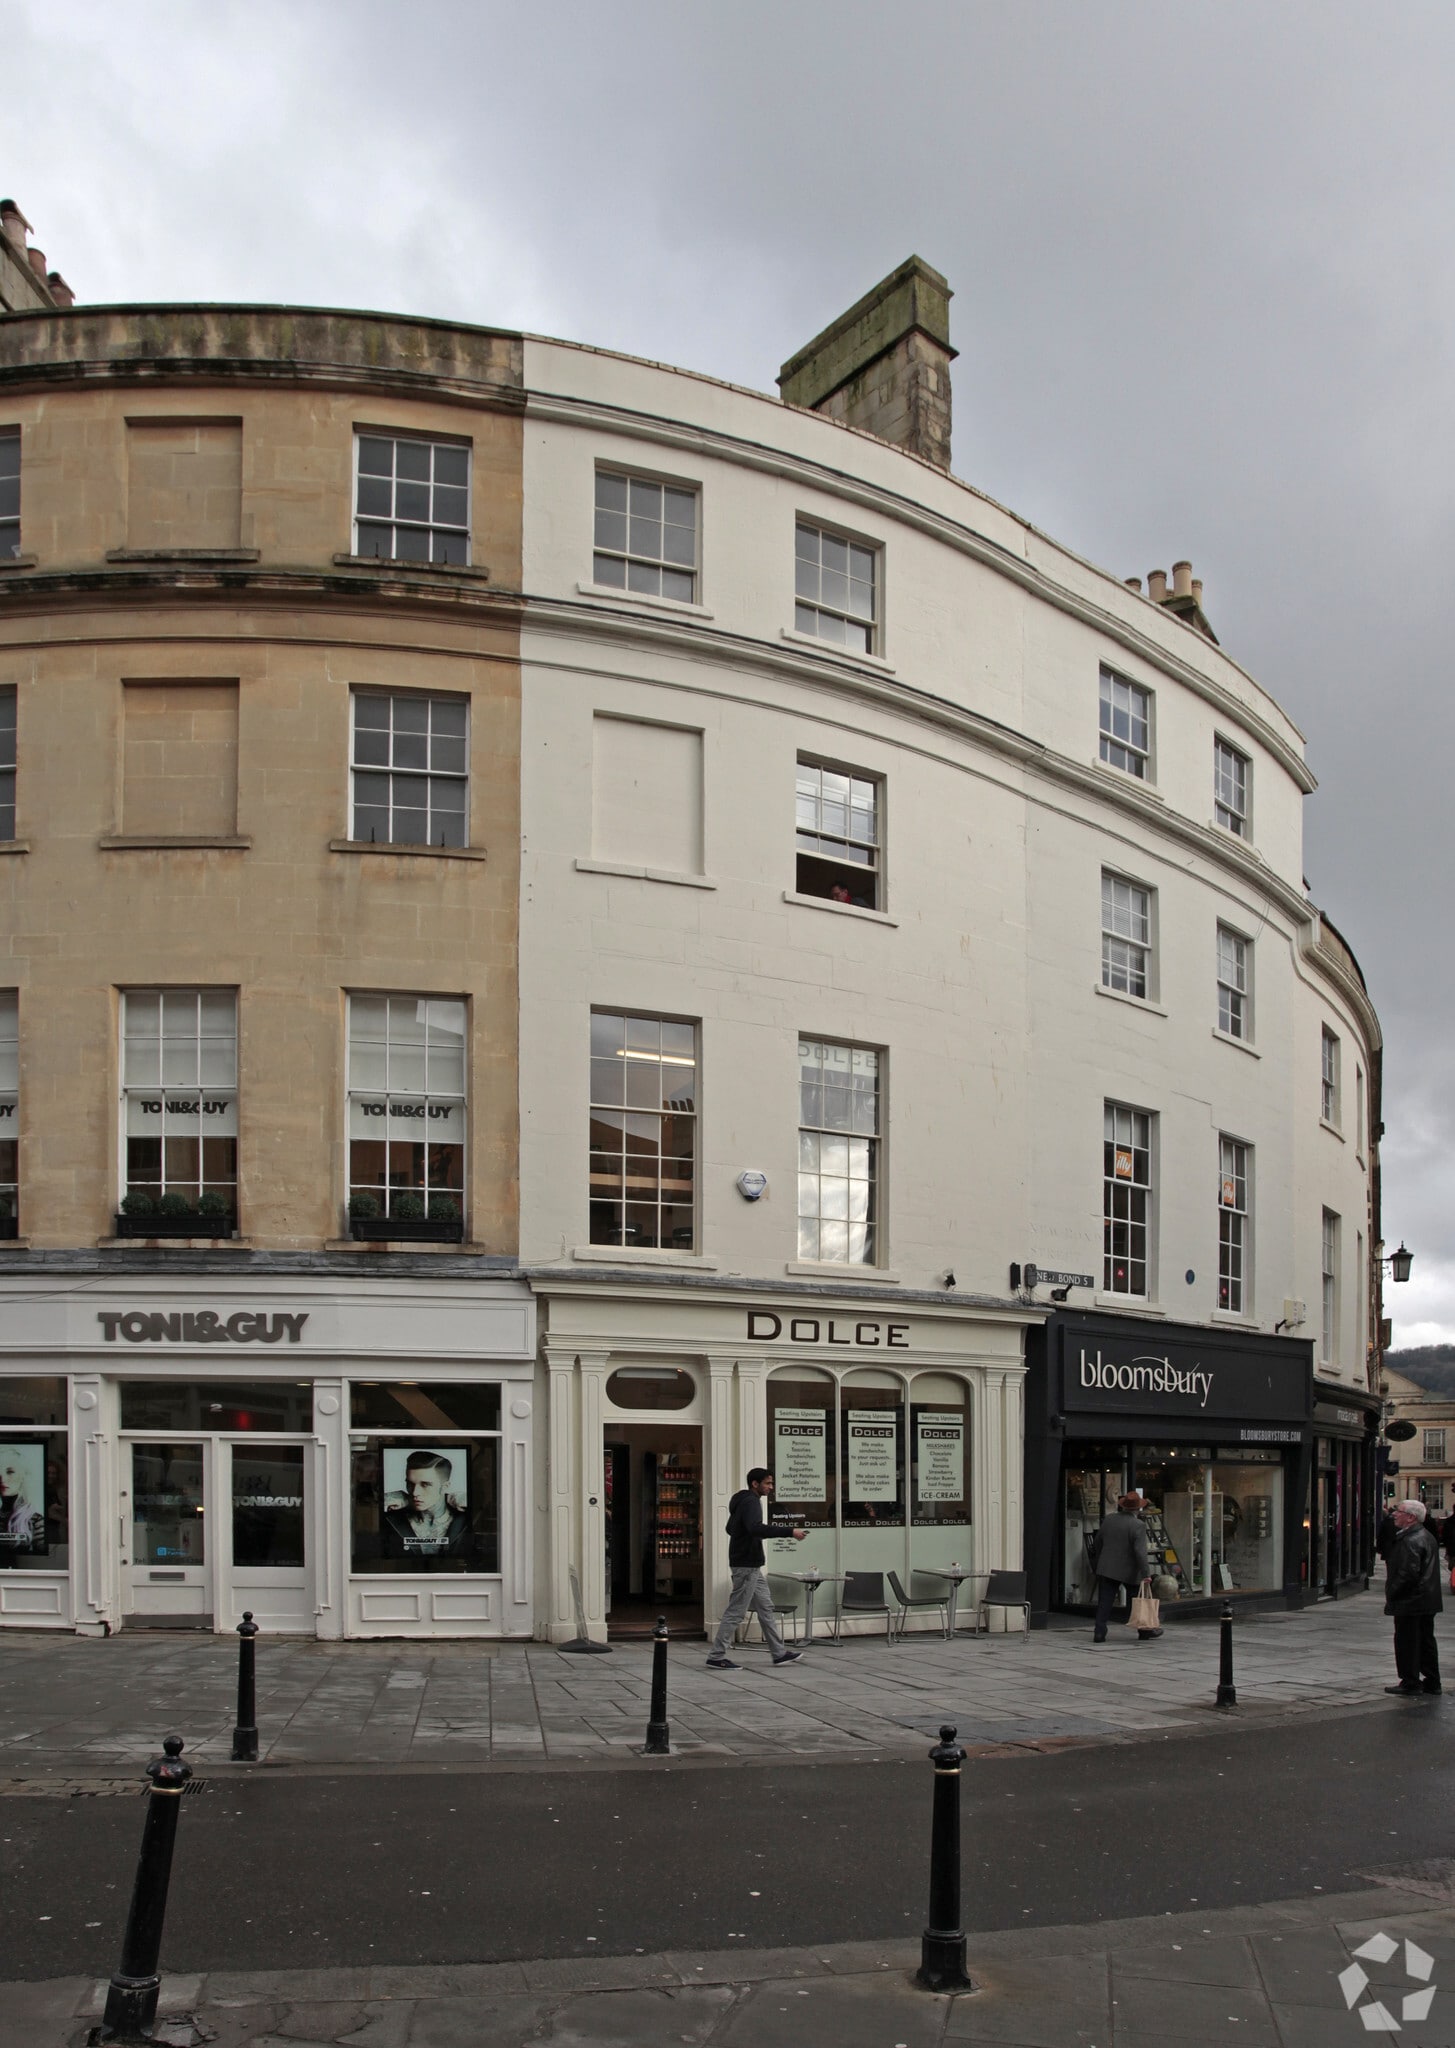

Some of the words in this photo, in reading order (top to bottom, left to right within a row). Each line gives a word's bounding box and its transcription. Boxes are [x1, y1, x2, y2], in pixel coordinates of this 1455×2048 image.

[140, 1101, 229, 1114] TONI&GUY
[360, 1103, 453, 1119] TONI&GUY
[1116, 1155, 1131, 1173] illy
[1058, 1273, 1080, 1285] BOND
[97, 1310, 310, 1343] TONI&GUY
[747, 1311, 909, 1348] DOLCE
[1080, 1349, 1214, 1408] bloomsbury
[782, 1426, 821, 1435] DOLCE
[854, 1428, 892, 1437] DOLCE
[923, 1430, 959, 1438] DOLCE
[1240, 1429, 1301, 1442] BLOOMSBURYSTORE.COM
[233, 1496, 302, 1507] TONI&GUY
